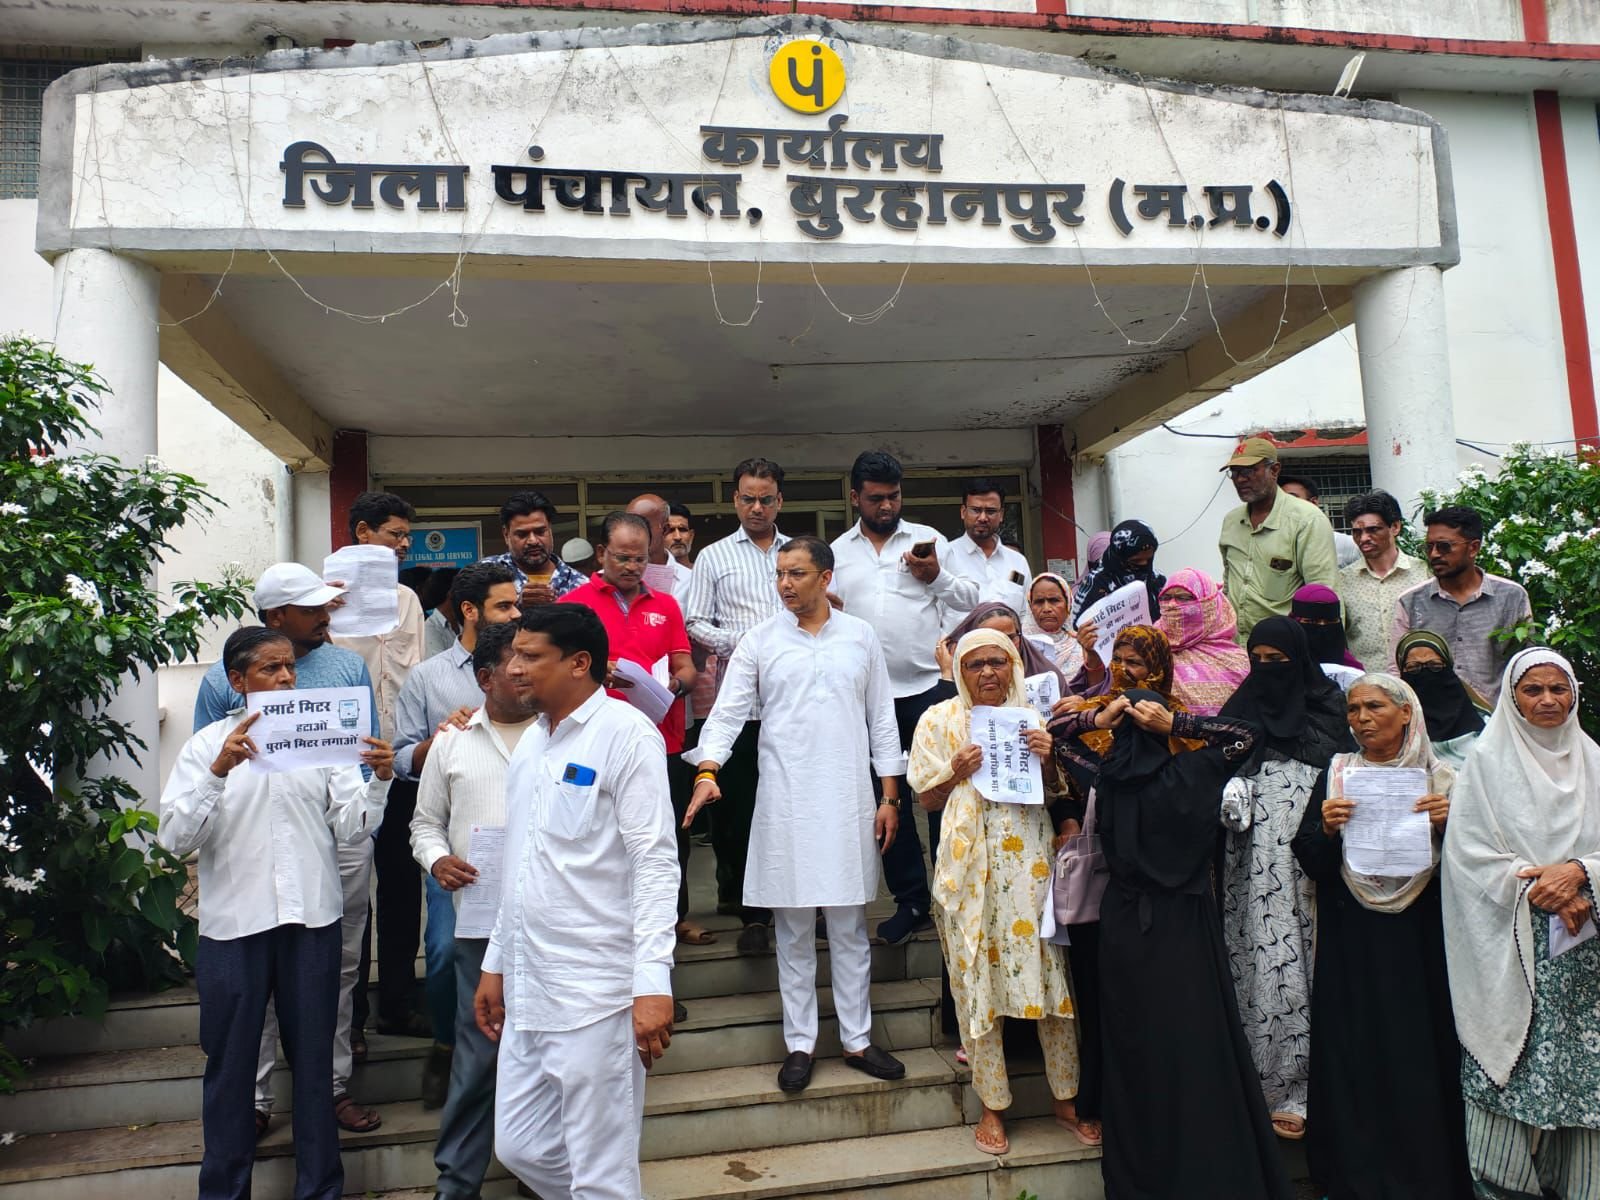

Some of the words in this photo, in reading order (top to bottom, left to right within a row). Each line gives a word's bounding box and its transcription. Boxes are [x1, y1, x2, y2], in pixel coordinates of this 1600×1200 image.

[787, 45, 823, 107] पं
[700, 114, 944, 172] कार्यालय
[280, 141, 470, 210] जिला
[786, 175, 1086, 244] बुरहानपुर
[415, 553, 432, 561] LEGAL
[435, 552, 446, 560] AID
[447, 552, 472, 560] SERVICES
[298, 700, 332, 714] मिटर
[296, 720, 329, 732] हटाओं
[266, 739, 291, 754] पुराने
[294, 738, 319, 749] मिटर
[321, 734, 359, 747] लगाओं
[1018, 747, 1031, 773] मिटर
